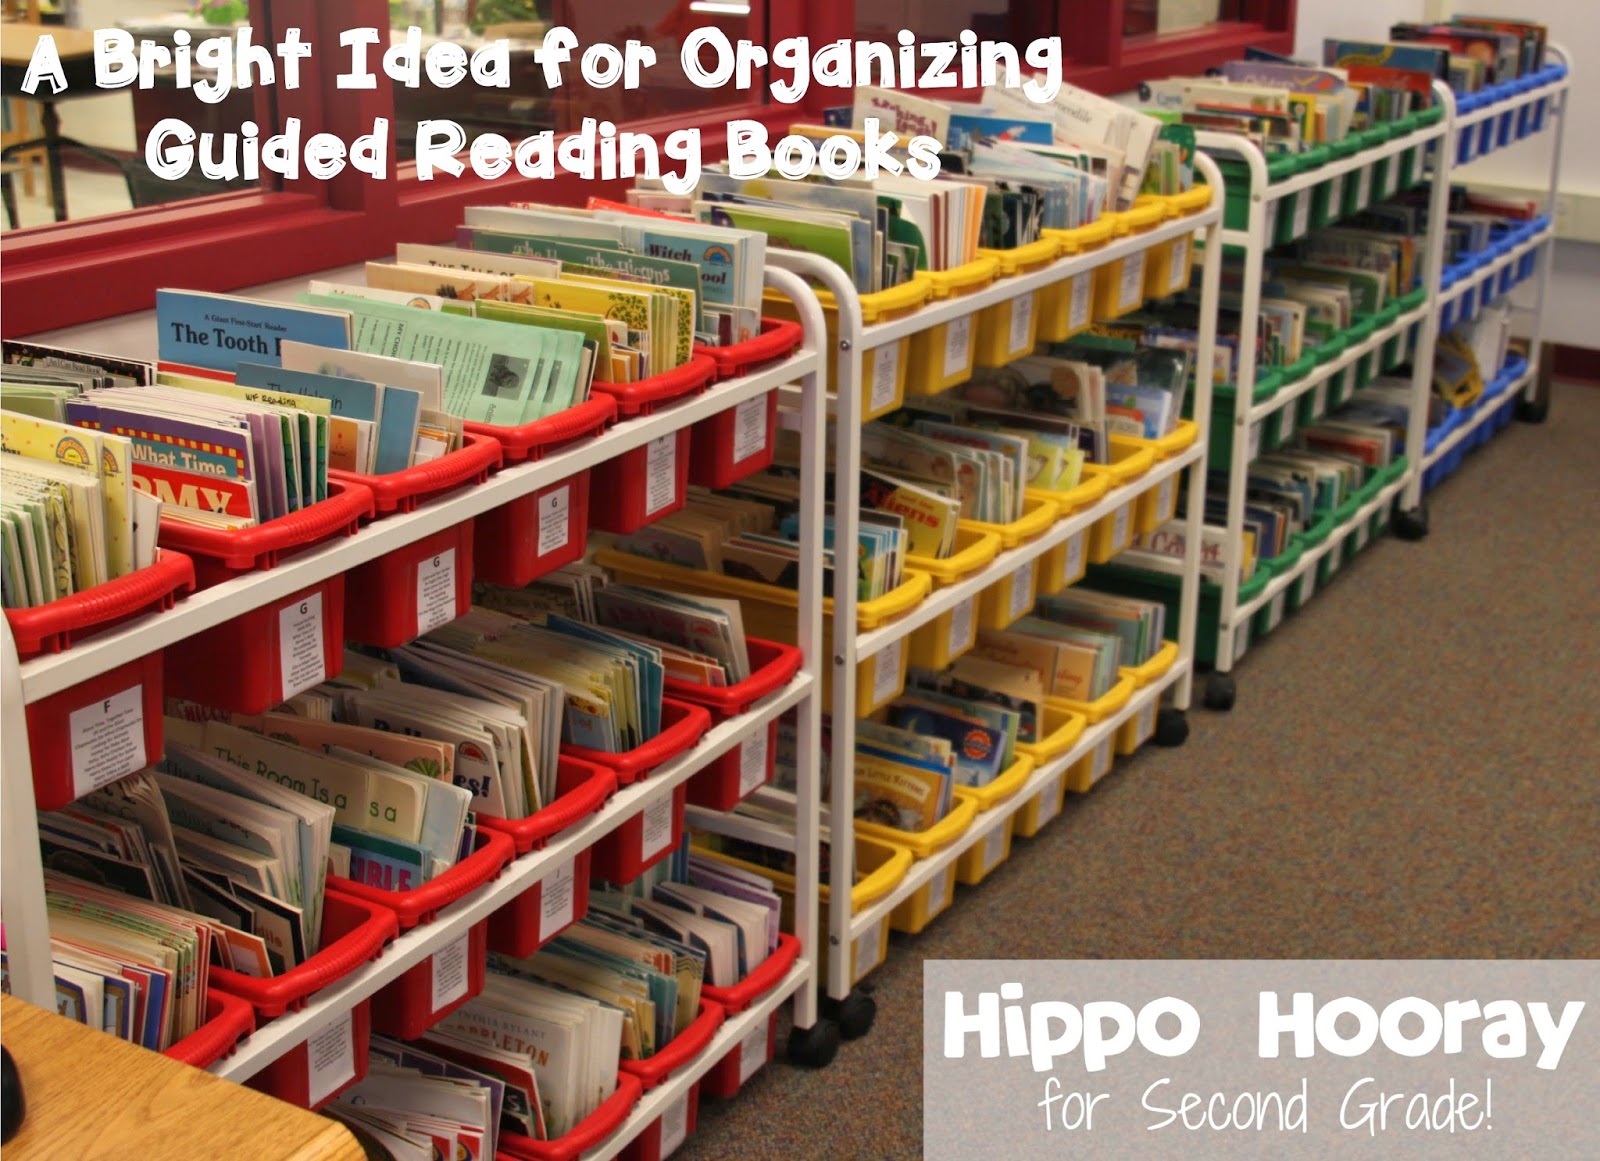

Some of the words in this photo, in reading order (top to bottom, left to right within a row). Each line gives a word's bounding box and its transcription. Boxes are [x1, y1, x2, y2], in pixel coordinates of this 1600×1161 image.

[649, 244, 692, 261] Witch
[171, 322, 209, 346] The
[213, 328, 268, 355] Tooth
[131, 443, 176, 466] What
[180, 451, 228, 477] Time
[433, 556, 440, 568] G
[300, 602, 308, 615] G
[104, 700, 111, 714] F
